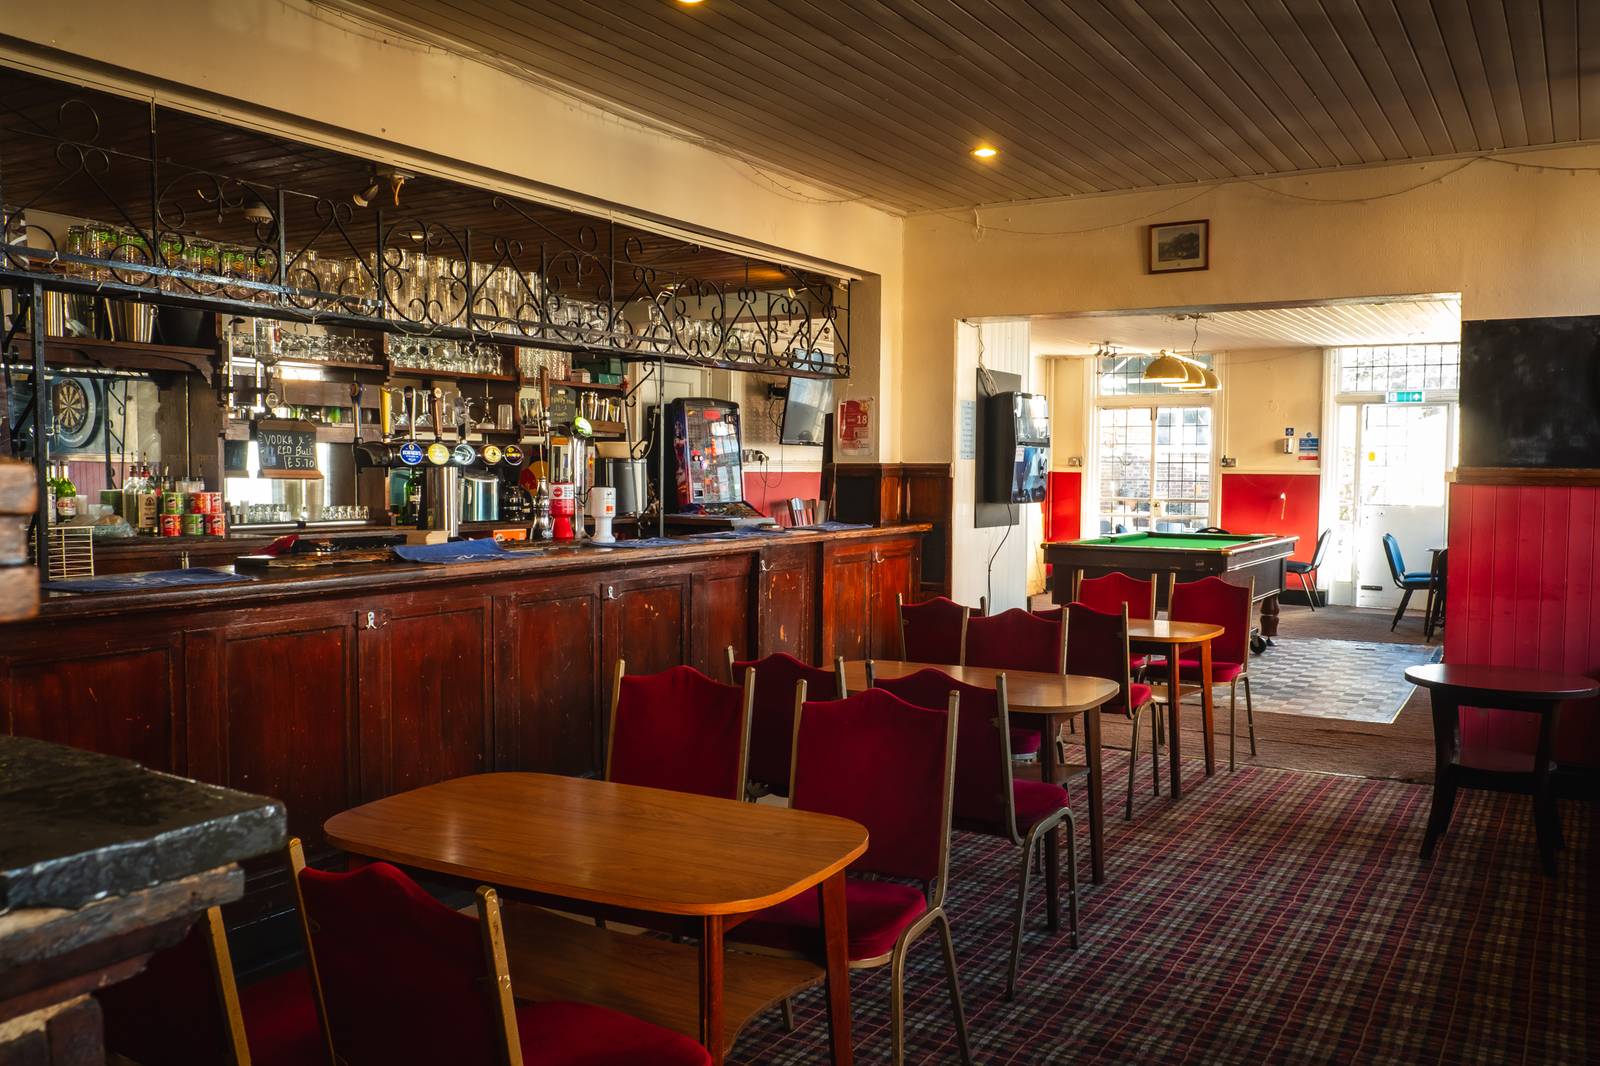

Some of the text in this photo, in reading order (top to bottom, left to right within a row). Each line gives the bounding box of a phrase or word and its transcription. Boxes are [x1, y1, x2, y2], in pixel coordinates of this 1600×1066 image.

[856, 415, 868, 425] 18
[264, 434, 293, 445] VODKA
[277, 445, 292, 455] RED
